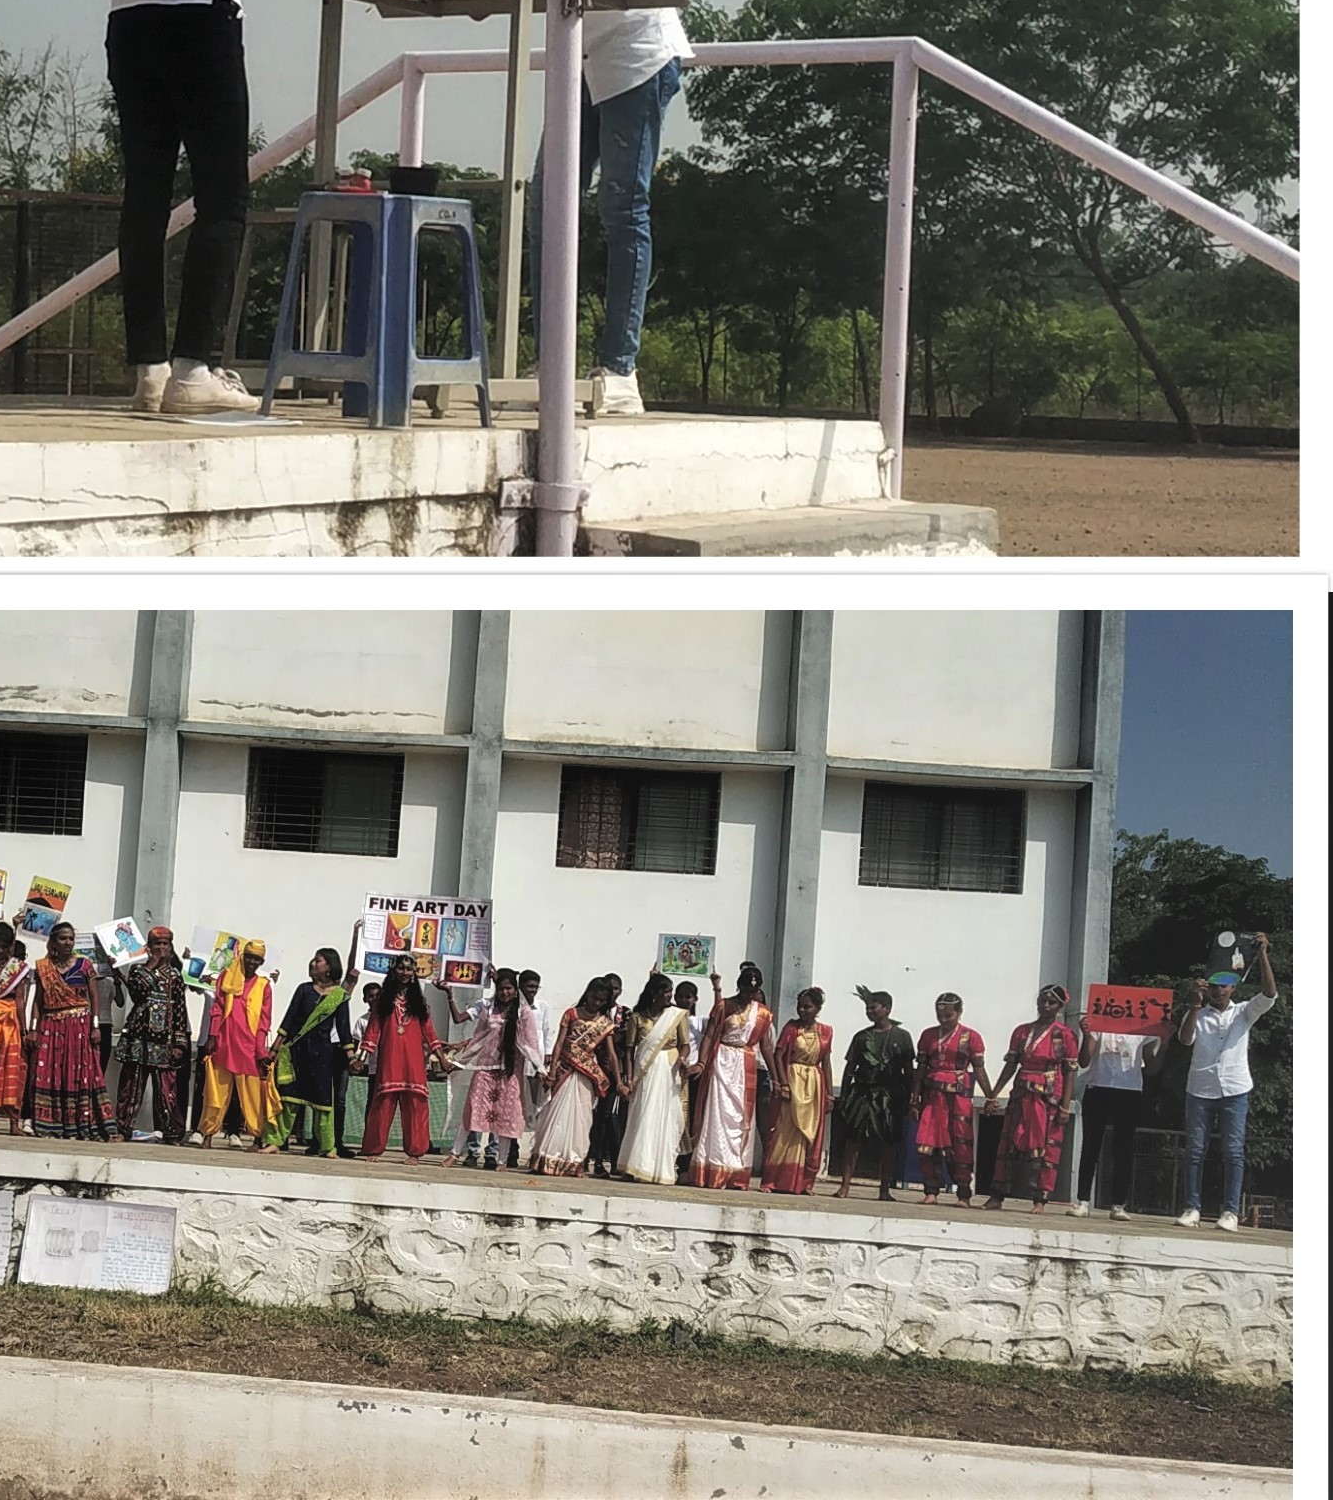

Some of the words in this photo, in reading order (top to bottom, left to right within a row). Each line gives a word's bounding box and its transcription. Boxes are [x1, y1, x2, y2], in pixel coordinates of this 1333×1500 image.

[369, 897, 409, 911] FINE
[413, 901, 448, 915] ART
[454, 904, 488, 917] DAY
